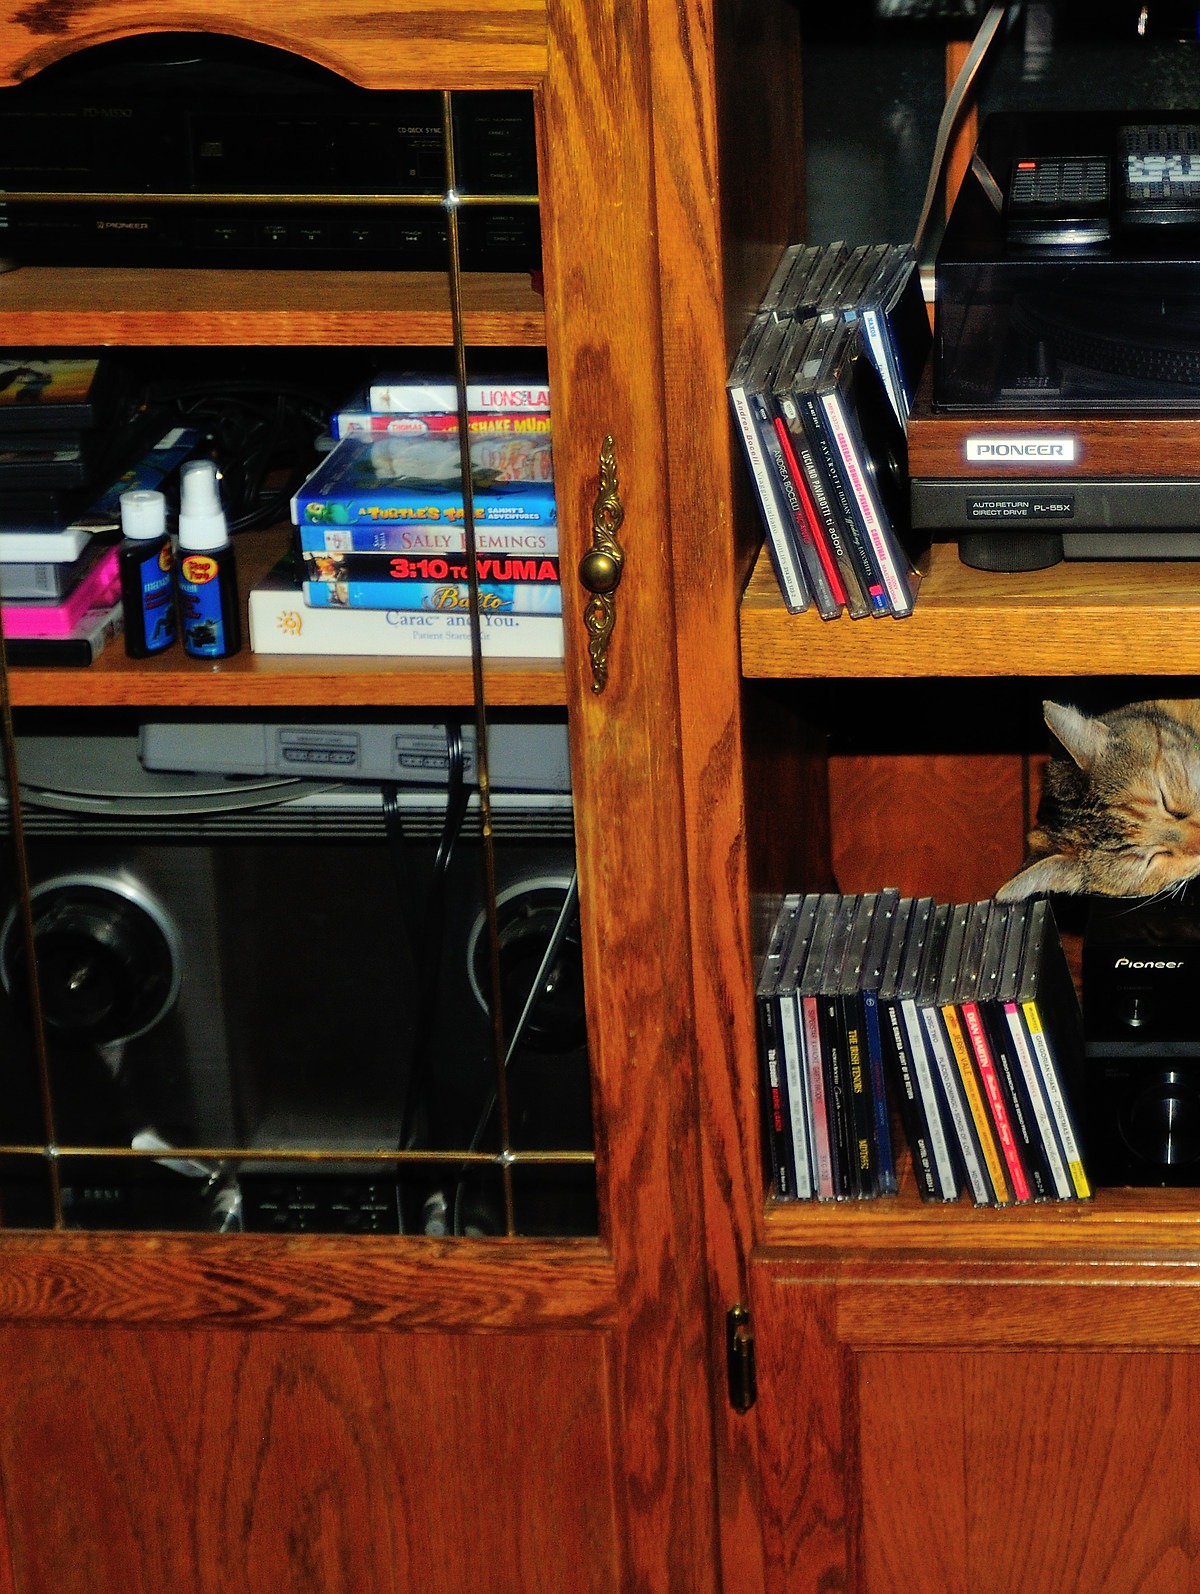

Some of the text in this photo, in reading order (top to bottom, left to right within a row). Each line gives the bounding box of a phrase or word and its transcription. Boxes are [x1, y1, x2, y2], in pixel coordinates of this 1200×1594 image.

[105, 222, 150, 231] PIONEER
[481, 390, 522, 407] LIONS
[736, 398, 750, 431] Andrea
[745, 433, 760, 466] Bocelli
[754, 469, 770, 503] Viaggio
[977, 444, 1064, 456] PIONEER
[772, 448, 789, 480] ANDREA
[783, 479, 800, 511] BOCELLI
[819, 439, 842, 489] PAVAROTTI
[837, 490, 851, 514] ITALIAN
[368, 506, 440, 520] TURTLE'S
[442, 507, 485, 522] TAE
[800, 448, 844, 556] LUCIANO PAVAROTTI ti adoro
[402, 532, 451, 550] SALLY
[869, 528, 886, 561] CHRISTMAS
[389, 559, 559, 580] 3:10 YUMA
[412, 631, 443, 641] Patient
[1114, 957, 1184, 969] Pioneer
[808, 1009, 816, 1038] SUPERSTAR
[887, 1006, 898, 1026] FRANK
[892, 1025, 903, 1050] SINATRA
[848, 1029, 862, 1094] THE IRISH TENORS
[897, 1050, 907, 1066] POINT
[952, 1031, 966, 1056] JERRY
[959, 1056, 972, 1076] VALE
[925, 1015, 934, 1029] DISC
[930, 1029, 938, 1043] TWO
[937, 1056, 949, 1081] PLACIDO
[945, 1081, 957, 1109] DOMINGO
[954, 1112, 964, 1132] SONGS
[962, 1141, 971, 1156] LOVE
[966, 1011, 979, 1035] DEAN
[973, 1034, 989, 1068] MARTIN
[997, 1121, 1011, 1146] Songs
[1034, 1034, 1074, 1153] GREGORIAN CHANT CHRISTMAS MASS
